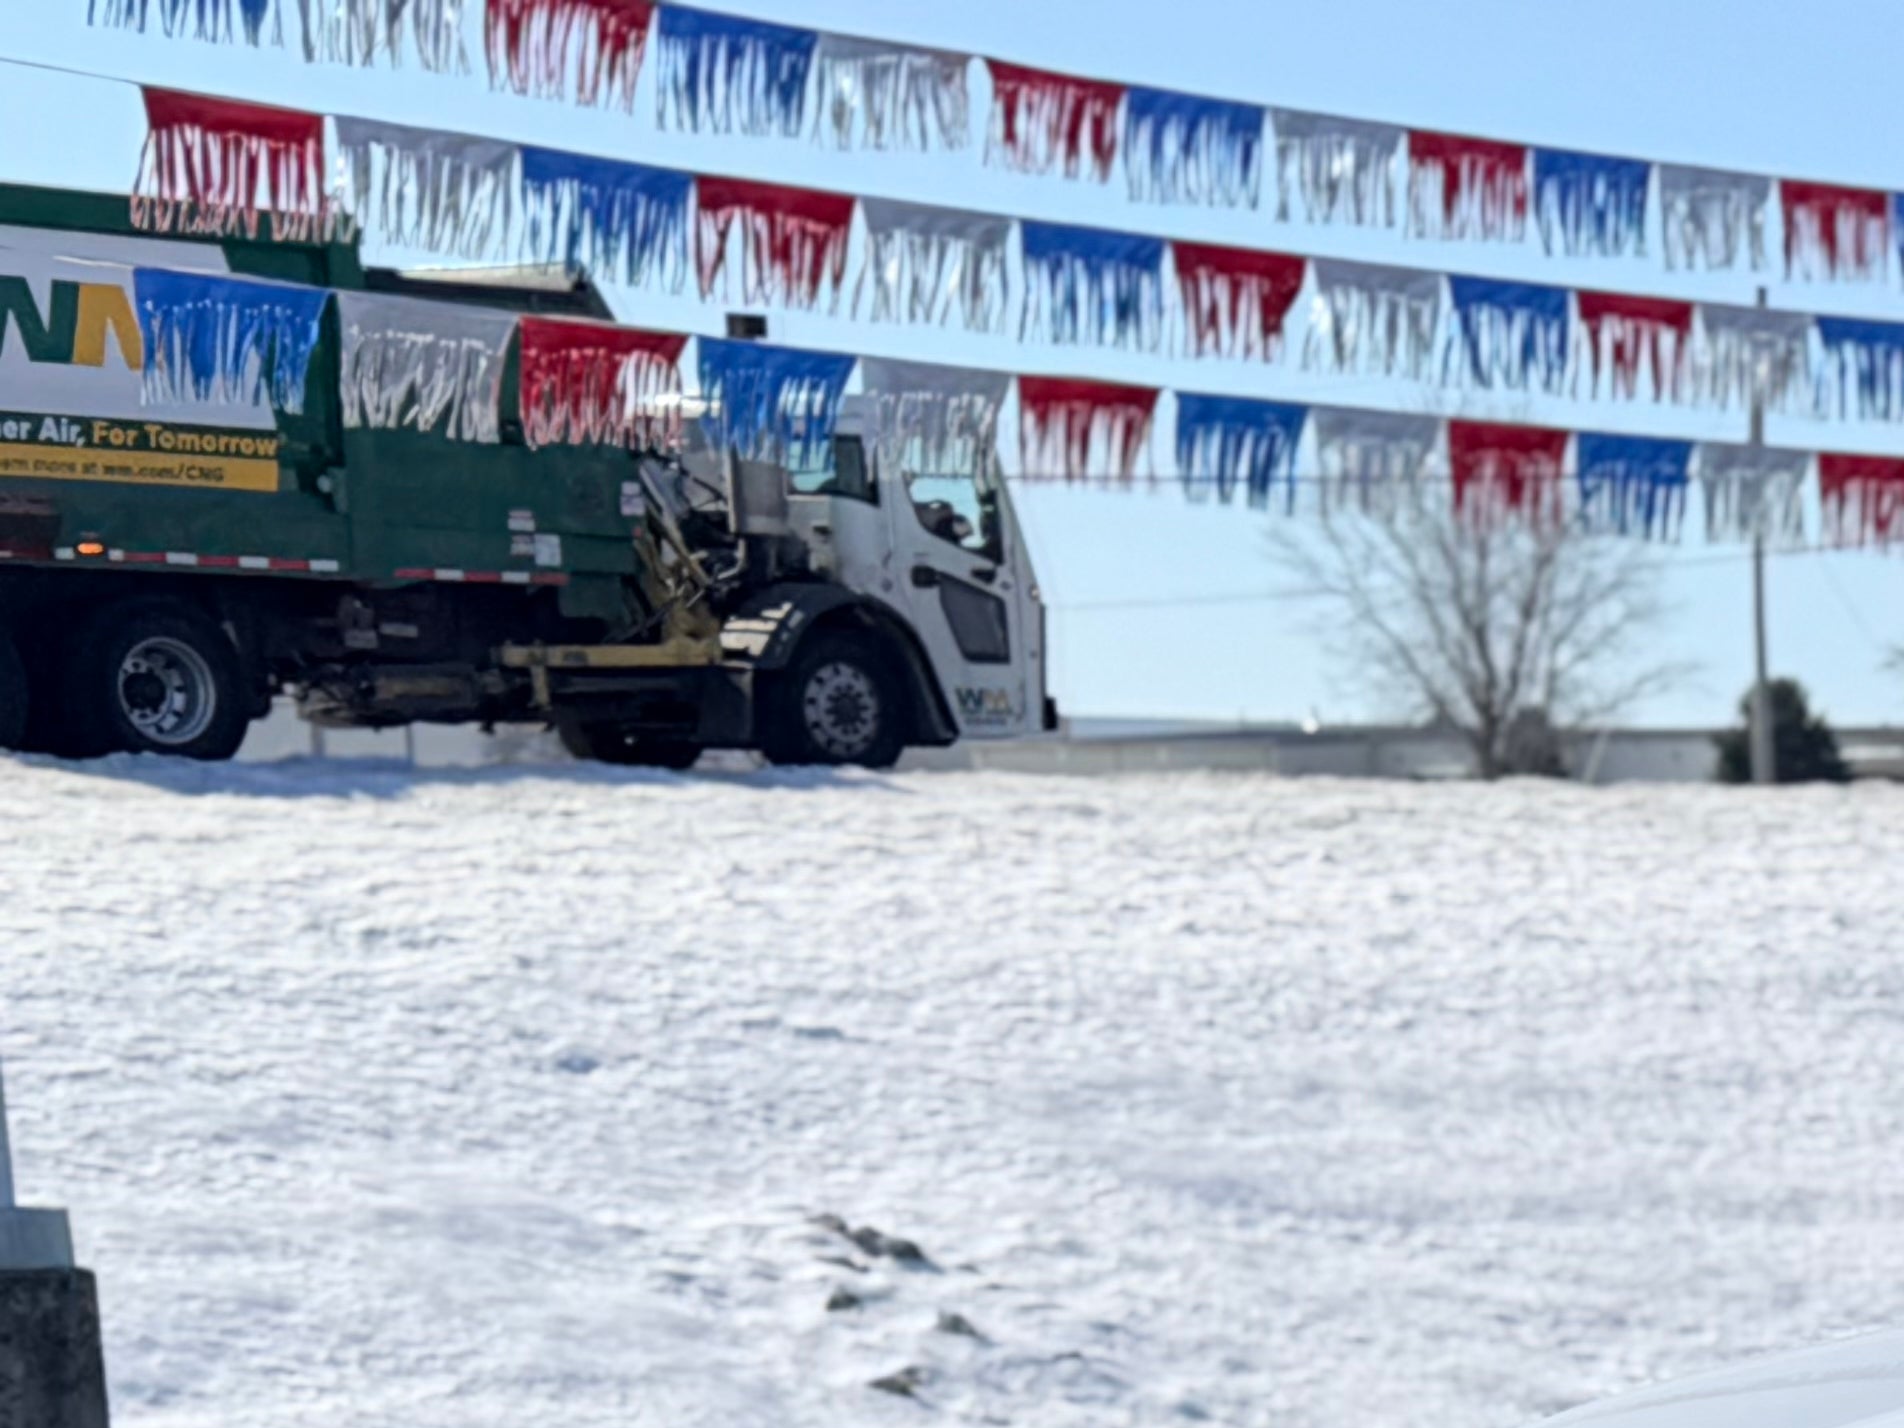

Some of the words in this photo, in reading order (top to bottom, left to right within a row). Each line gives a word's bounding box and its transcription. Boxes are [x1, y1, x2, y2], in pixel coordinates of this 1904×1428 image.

[0, 420, 31, 440] er
[38, 416, 85, 448] Air,
[92, 420, 138, 447] For
[144, 424, 278, 457] Tomorrow
[954, 687, 1013, 716] WM
